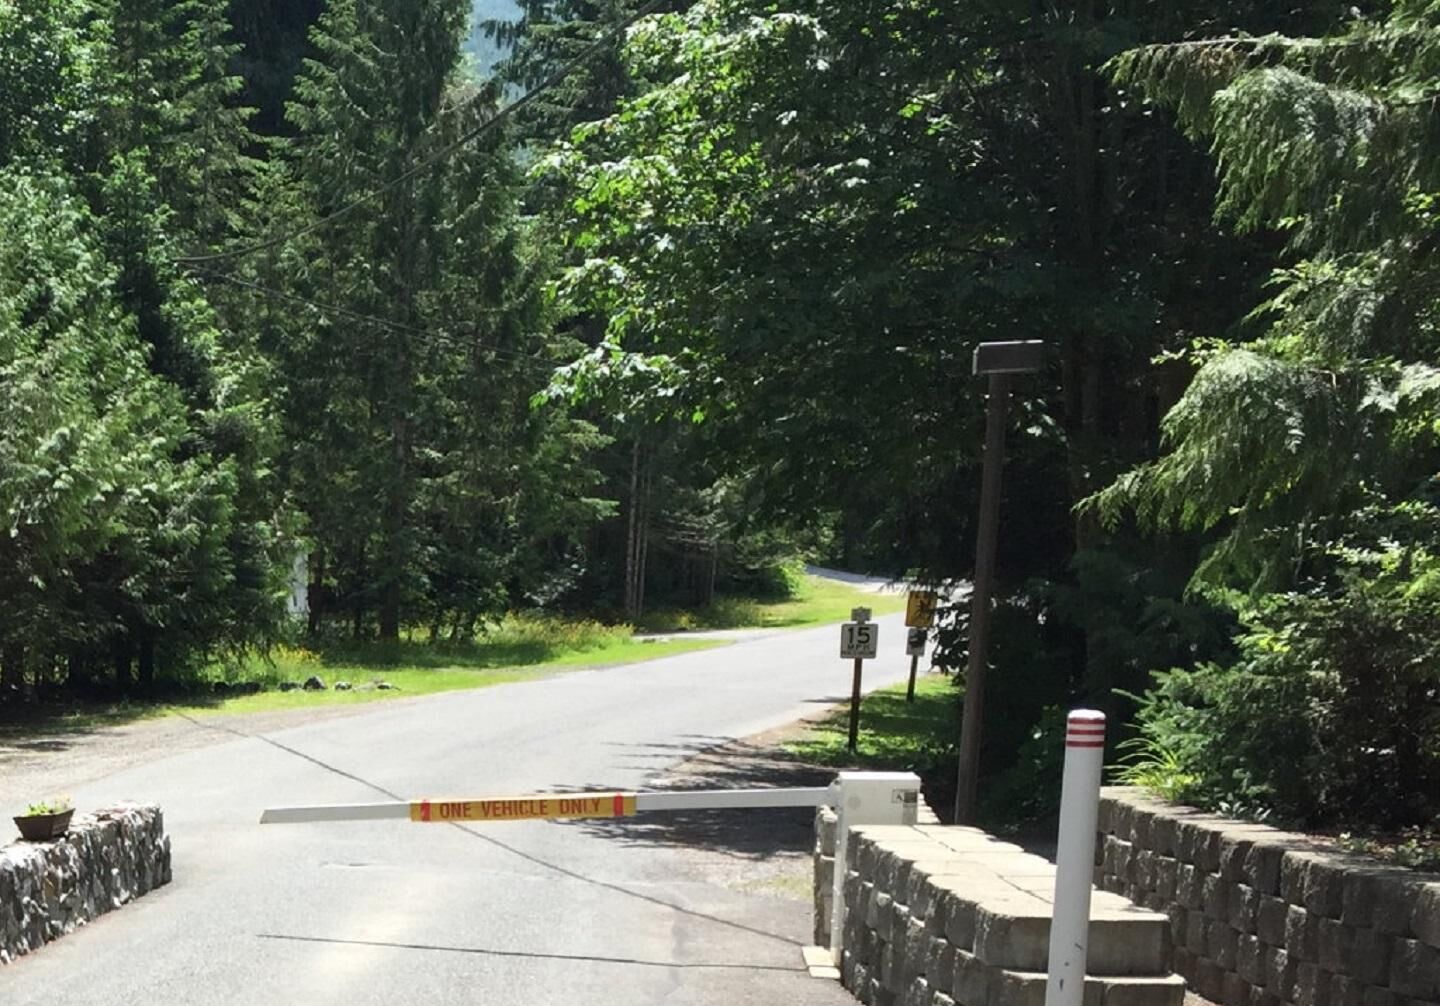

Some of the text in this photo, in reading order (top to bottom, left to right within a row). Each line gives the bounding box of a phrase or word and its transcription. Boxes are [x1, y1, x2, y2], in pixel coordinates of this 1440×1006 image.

[847, 626, 870, 644] 15
[439, 798, 601, 818] ONE VEHICLE ONLY
